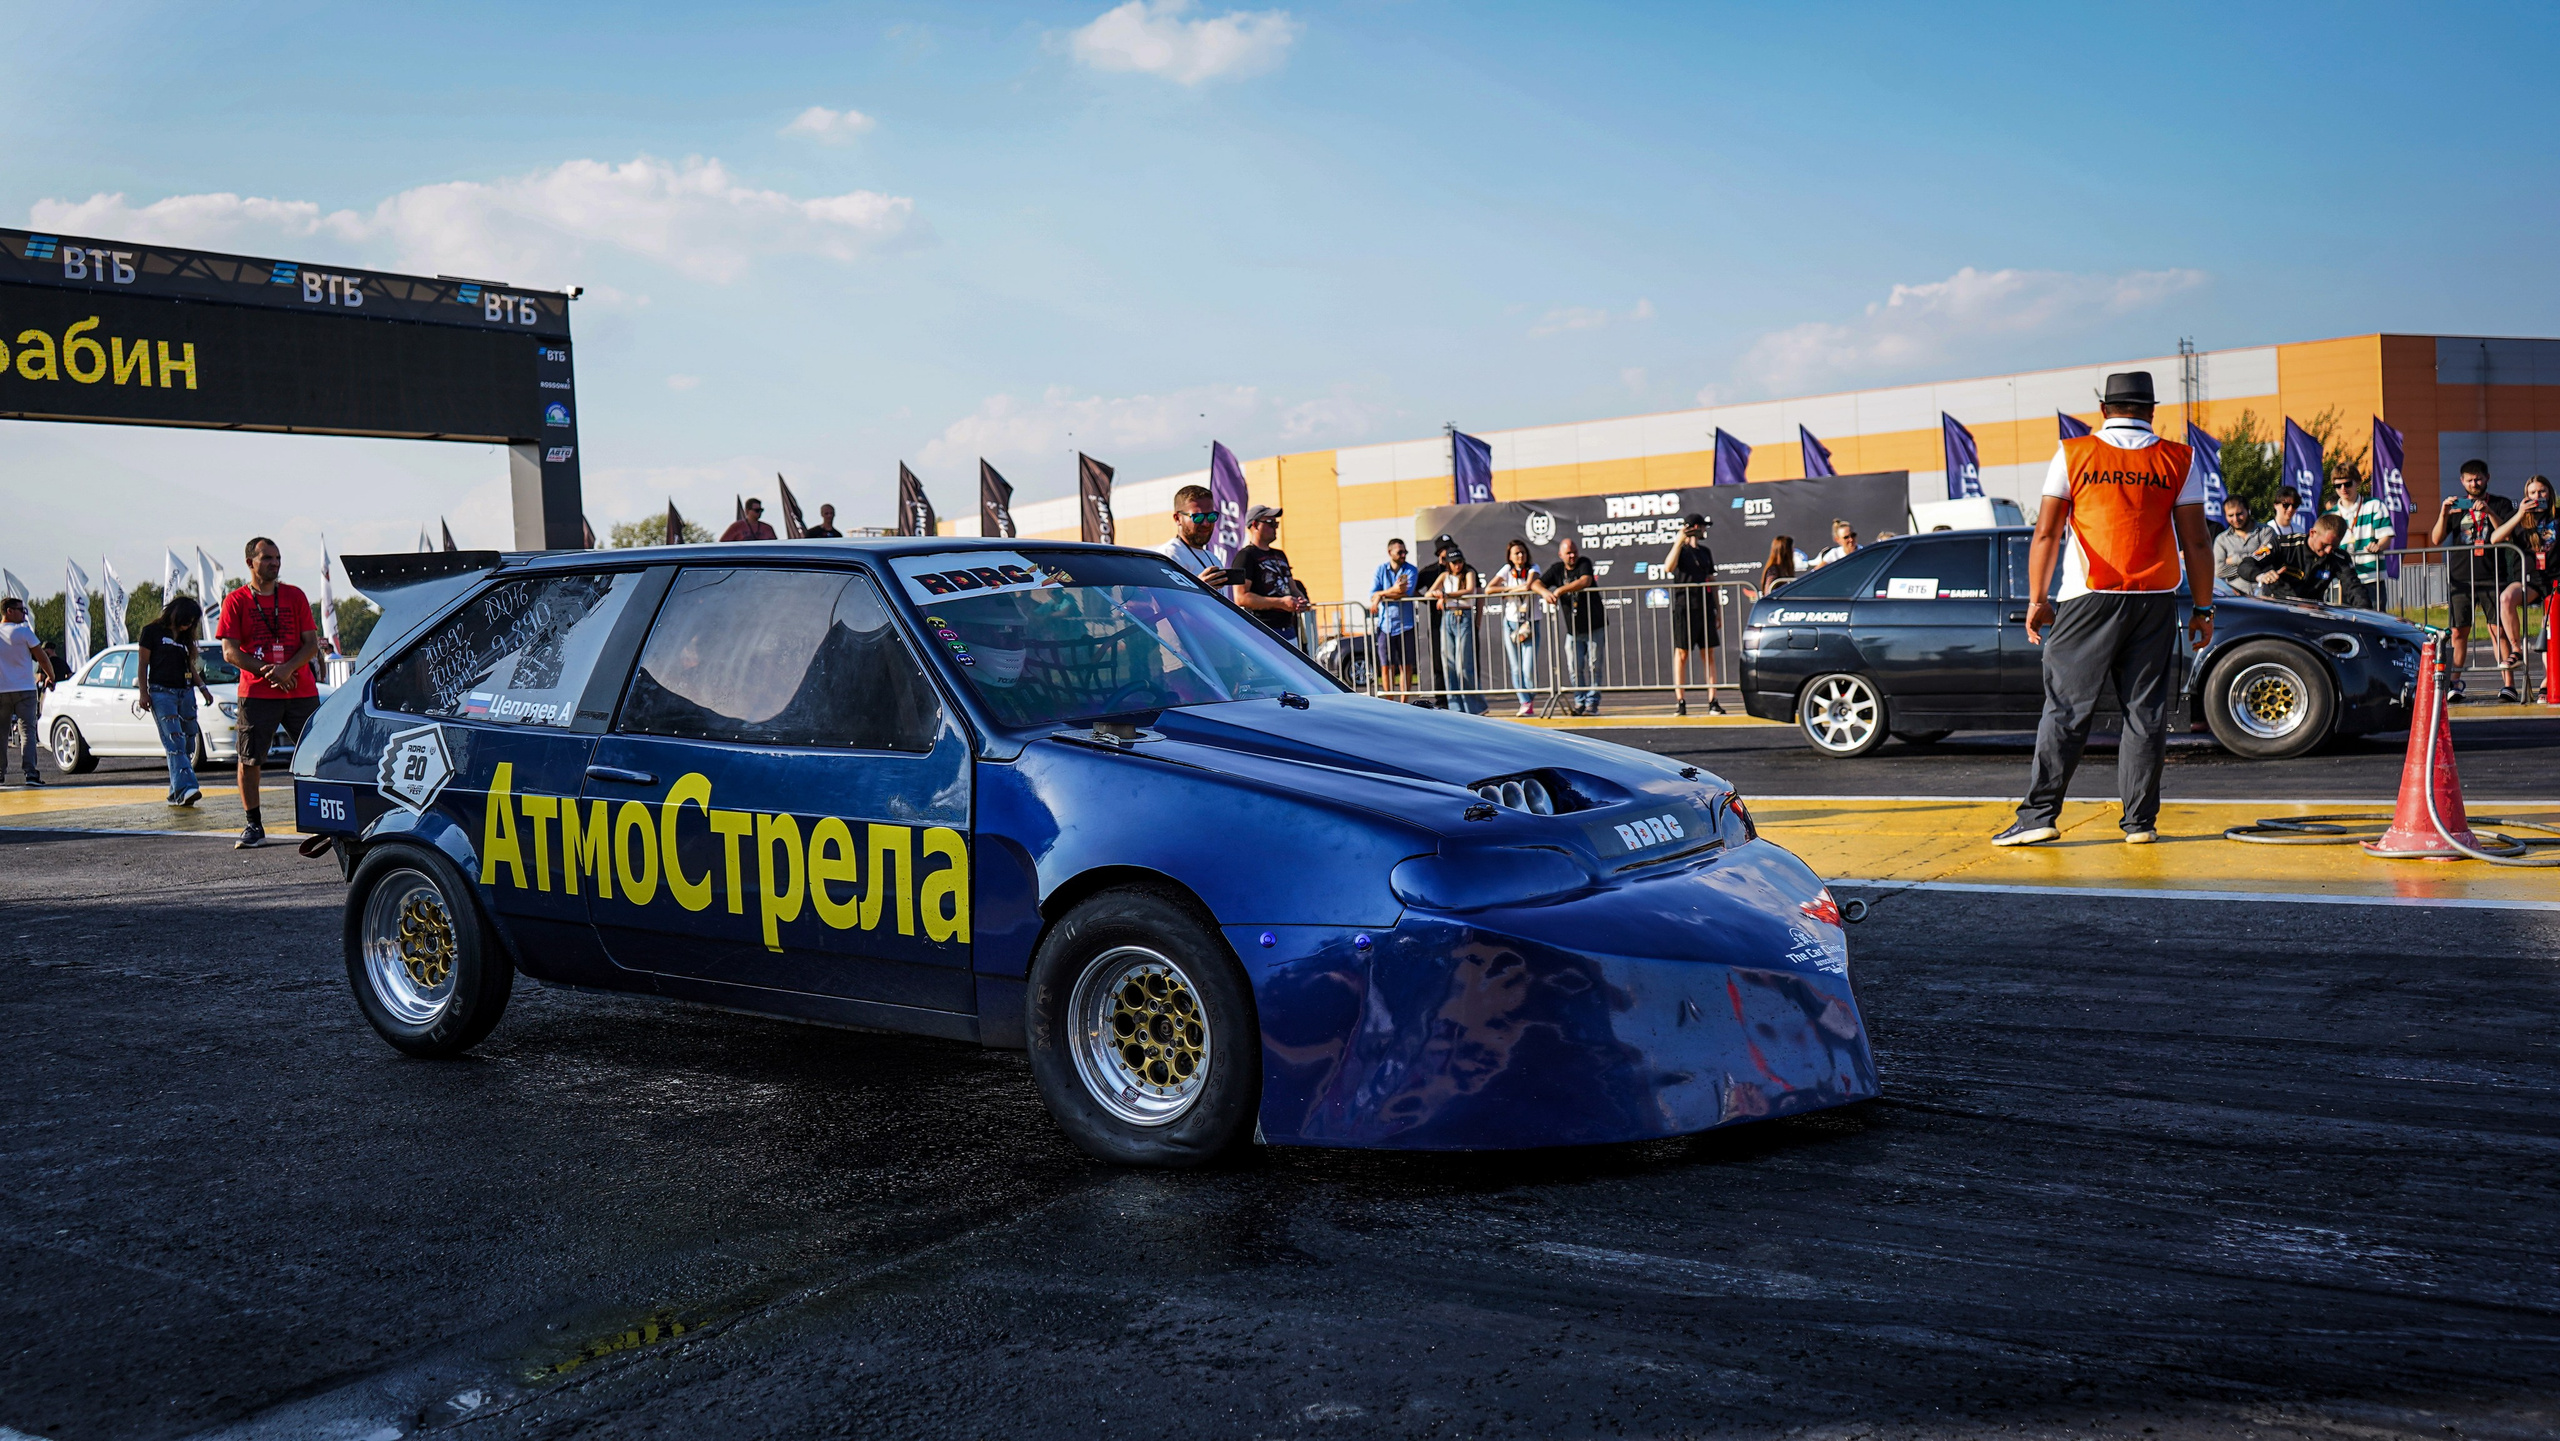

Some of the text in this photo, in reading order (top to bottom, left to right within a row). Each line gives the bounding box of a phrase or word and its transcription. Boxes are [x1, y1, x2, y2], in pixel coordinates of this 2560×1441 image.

[63, 246, 135, 284] ВТБ
[302, 271, 364, 307] ВТБ
[483, 293, 538, 325] ВТБ
[546, 350, 566, 362] ВТБ
[1961, 462, 1978, 498] ТБ
[2083, 469, 2171, 490] MARSHAL
[2298, 469, 2315, 513] ВТБ
[2384, 468, 2403, 512] ВТБ
[1605, 493, 1680, 519] RDRC
[1744, 498, 1773, 514] ВТБ
[2204, 472, 2222, 516] ВТБ
[1219, 500, 1240, 549] ВТБ
[1577, 519, 1654, 536] ЧЕМПИОНАТ
[1582, 536, 1600, 549] ПО
[912, 564, 1035, 596] RDRC
[1908, 585, 1927, 594] ВТБ
[491, 602, 551, 656] 9.890
[1781, 611, 1848, 623] SMP RACING
[489, 694, 571, 721] Цепляев А
[408, 745, 426, 753] RDRC
[404, 755, 428, 781] 20
[320, 798, 346, 821] ВТБ
[1614, 813, 1685, 850] RDRC
[480, 762, 971, 952] АтмоСтрела
[1785, 953, 1809, 963] The
[1805, 948, 1824, 958] Car
